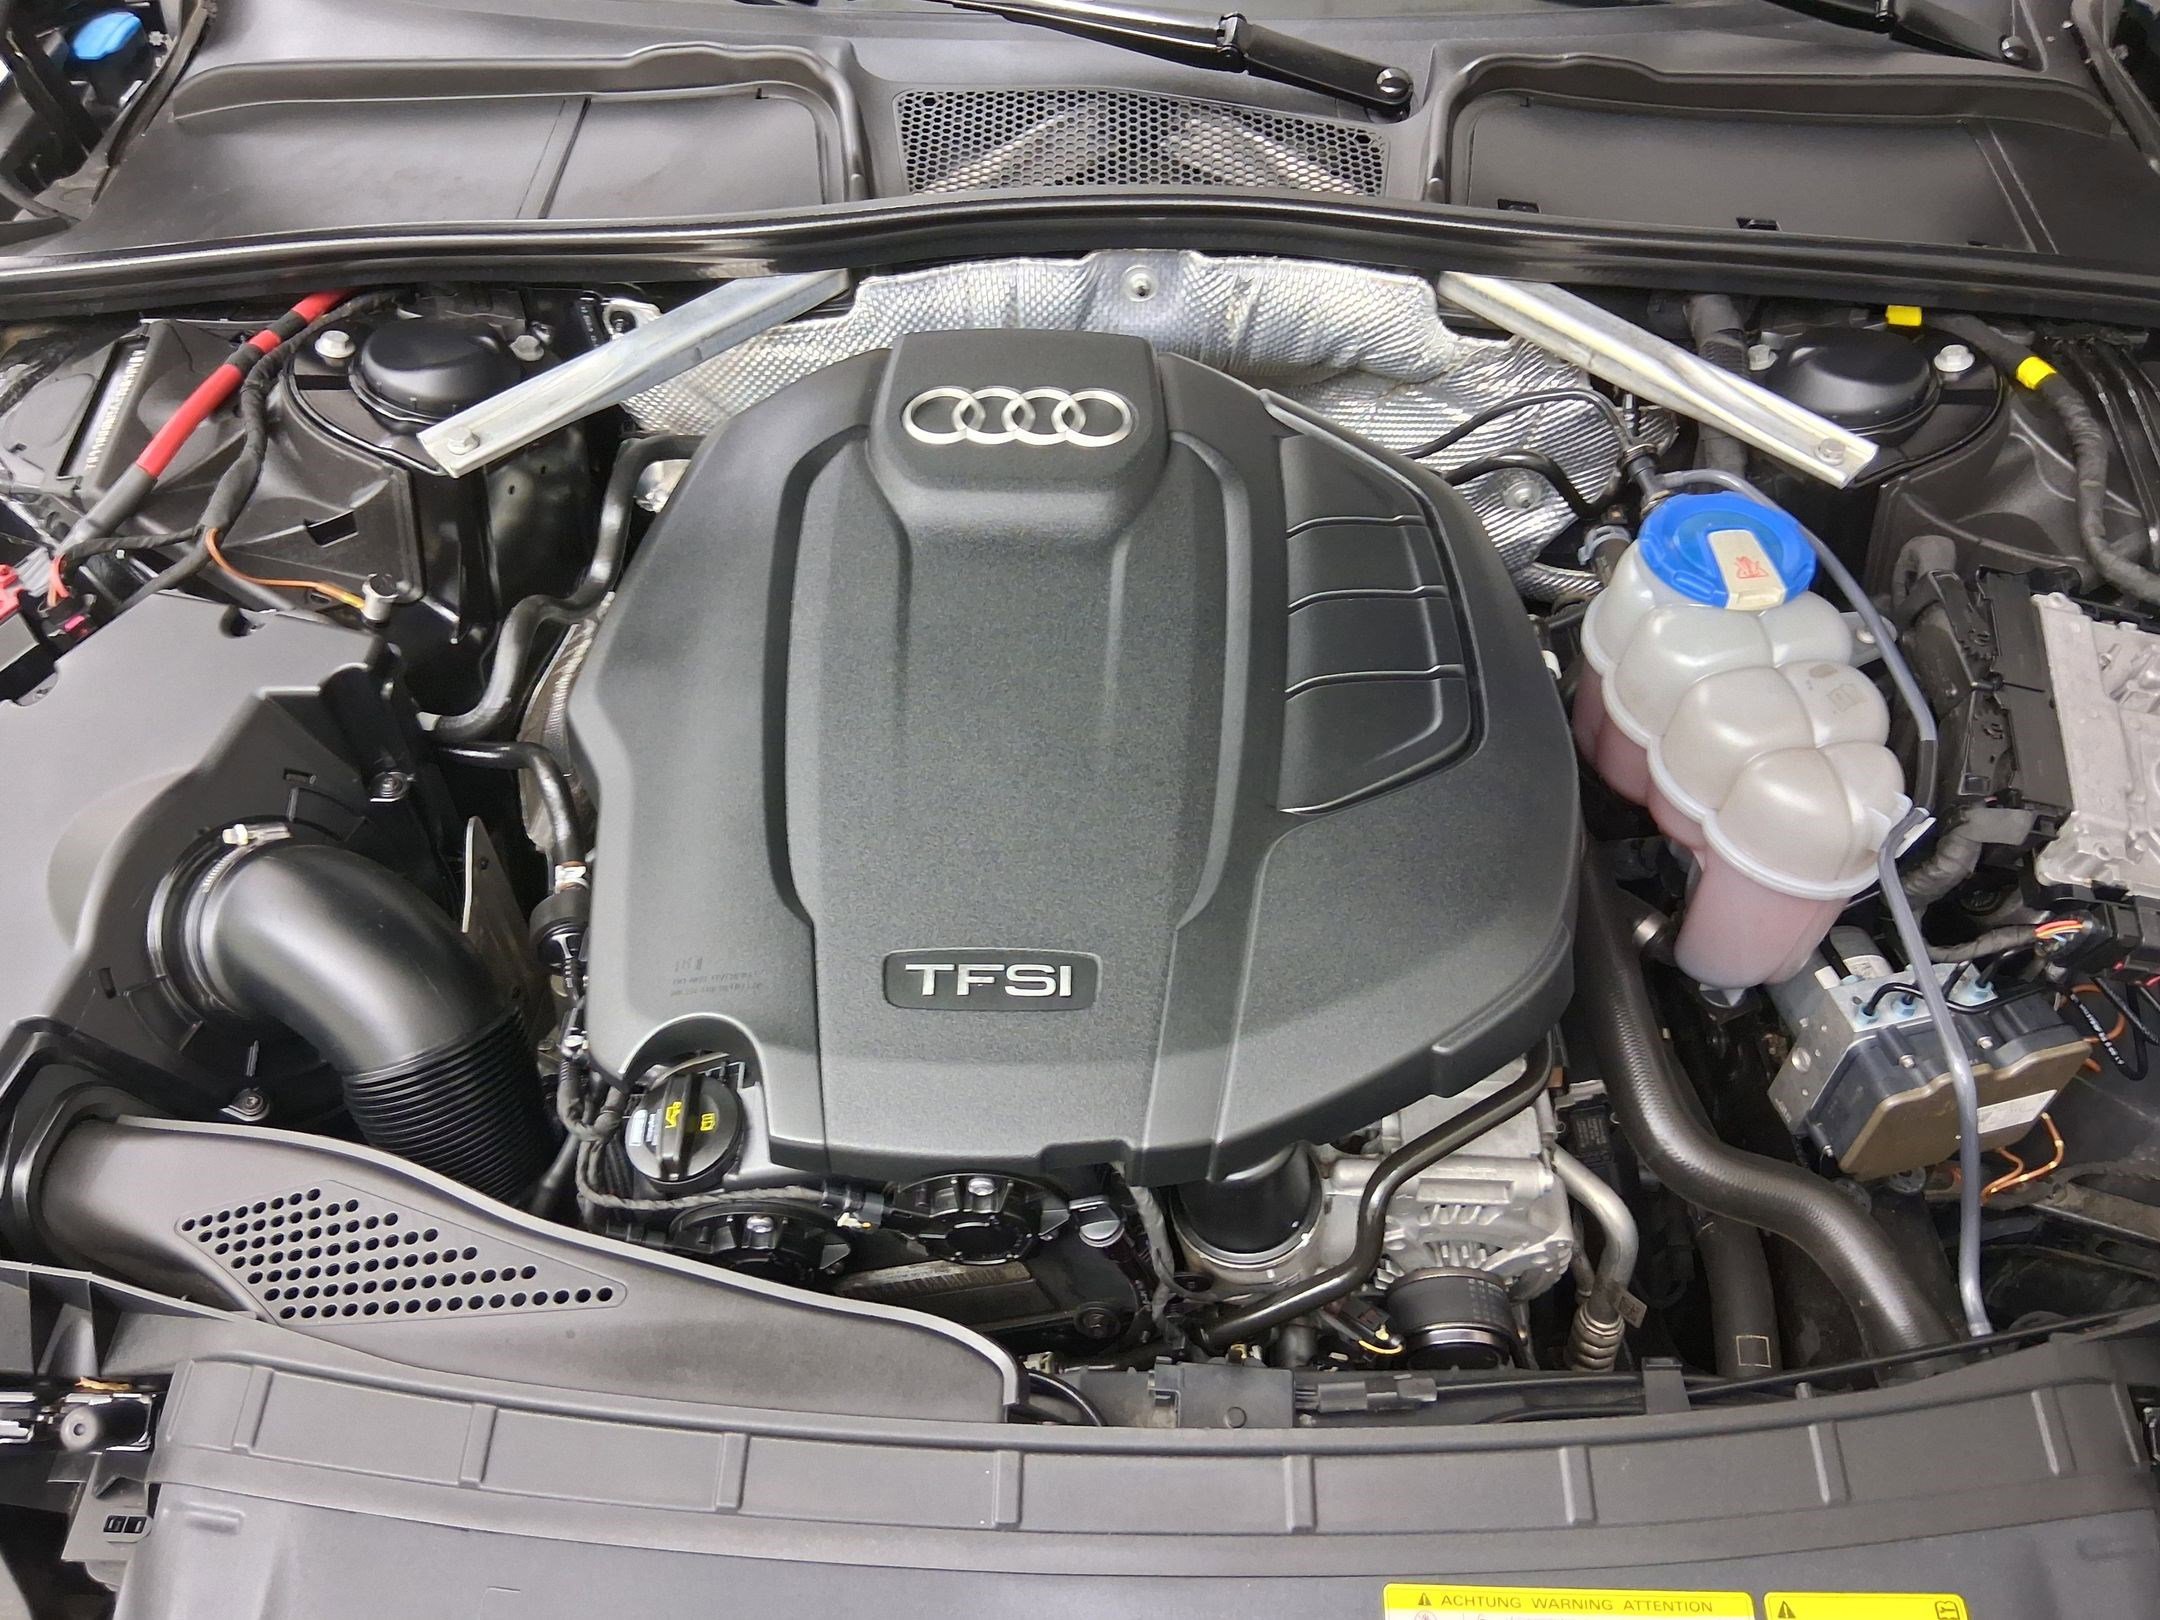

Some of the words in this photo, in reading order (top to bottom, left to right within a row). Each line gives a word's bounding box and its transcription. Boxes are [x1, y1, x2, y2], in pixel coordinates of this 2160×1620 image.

[905, 964, 1072, 997] TFSI
[1440, 1595, 1522, 1609] ACHTUNG
[1531, 1597, 1613, 1611] WARNING
[1623, 1599, 1713, 1613] ATTENTION
